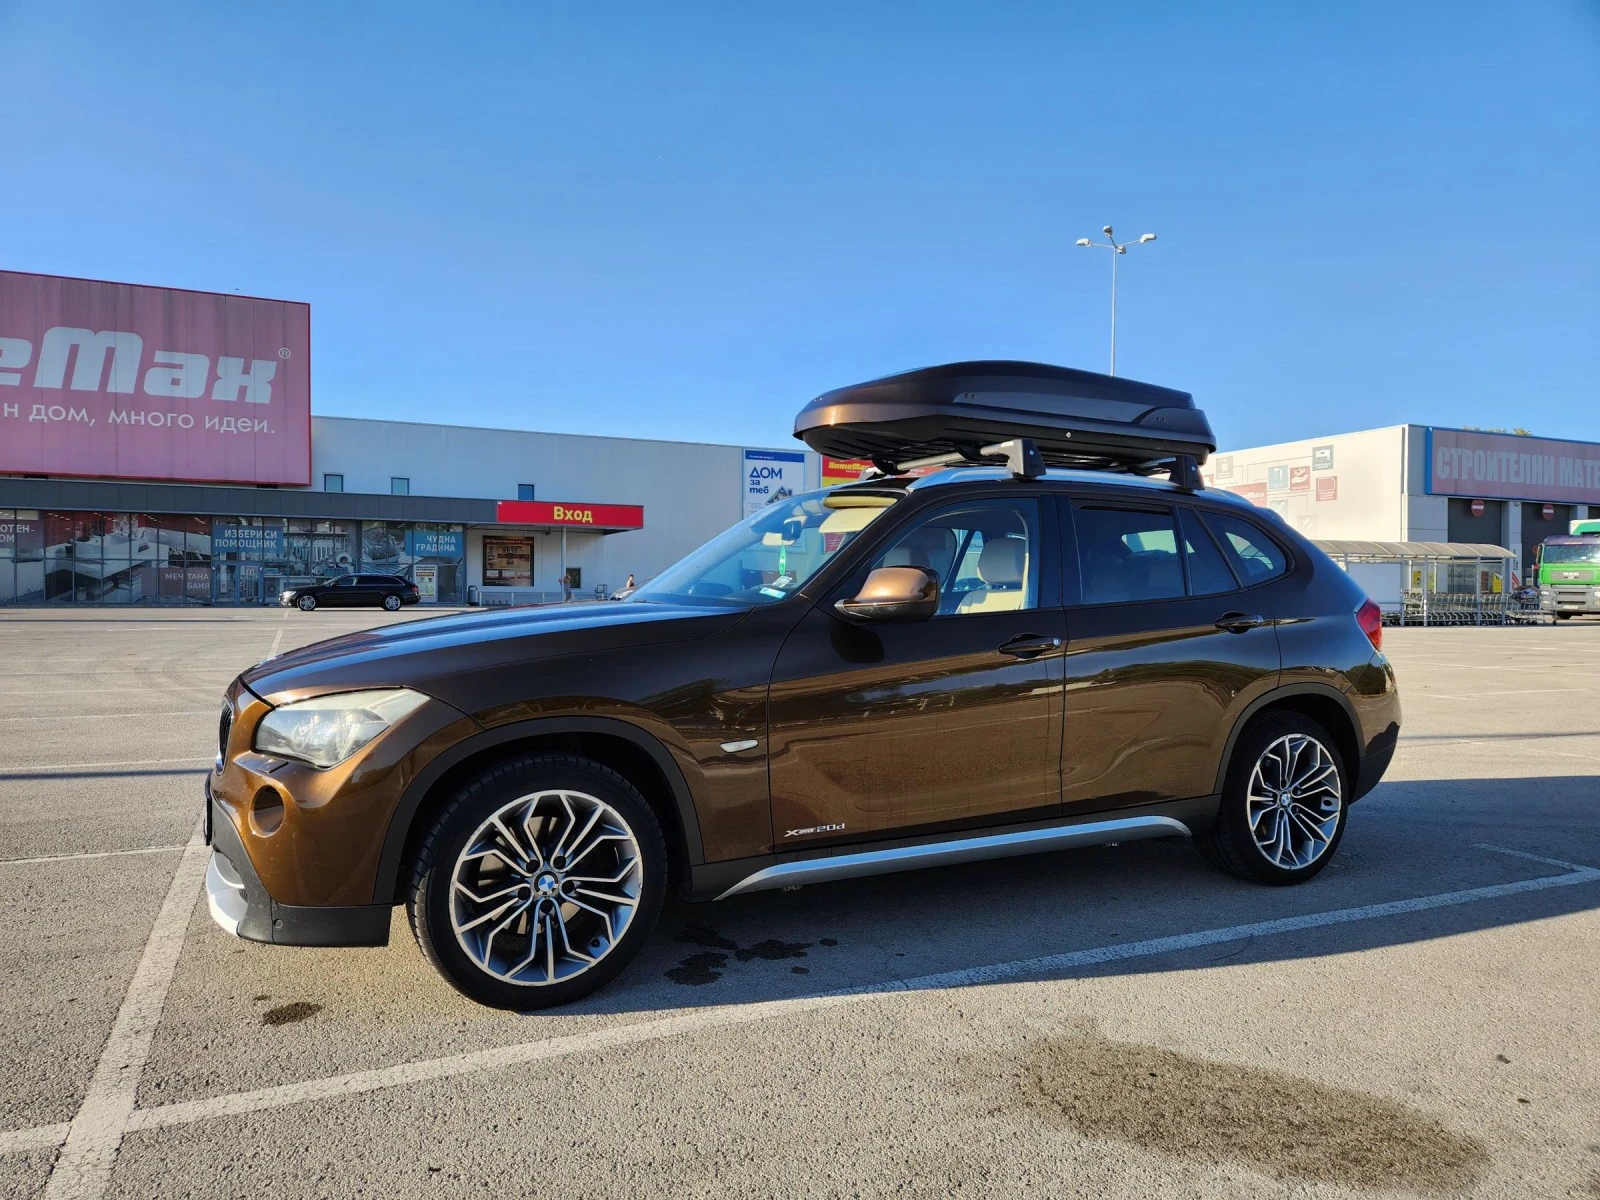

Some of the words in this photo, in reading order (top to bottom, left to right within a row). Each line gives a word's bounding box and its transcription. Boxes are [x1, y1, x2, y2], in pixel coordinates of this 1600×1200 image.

[29, 404, 96, 427] дом,
[108, 408, 195, 429] много
[205, 415, 276, 435] идеи.
[1436, 446, 1555, 486] СТРОИТЕЛНИ
[749, 466, 783, 480] ДОМ
[749, 485, 769, 494] теб
[553, 505, 593, 524] Вход
[224, 529, 263, 539] ИЗБЕРИ
[264, 530, 278, 539] СИ
[426, 535, 456, 544] ЧУДНА
[214, 538, 277, 550] ПОМОЩНИК
[415, 543, 456, 552] ГРАДИНА
